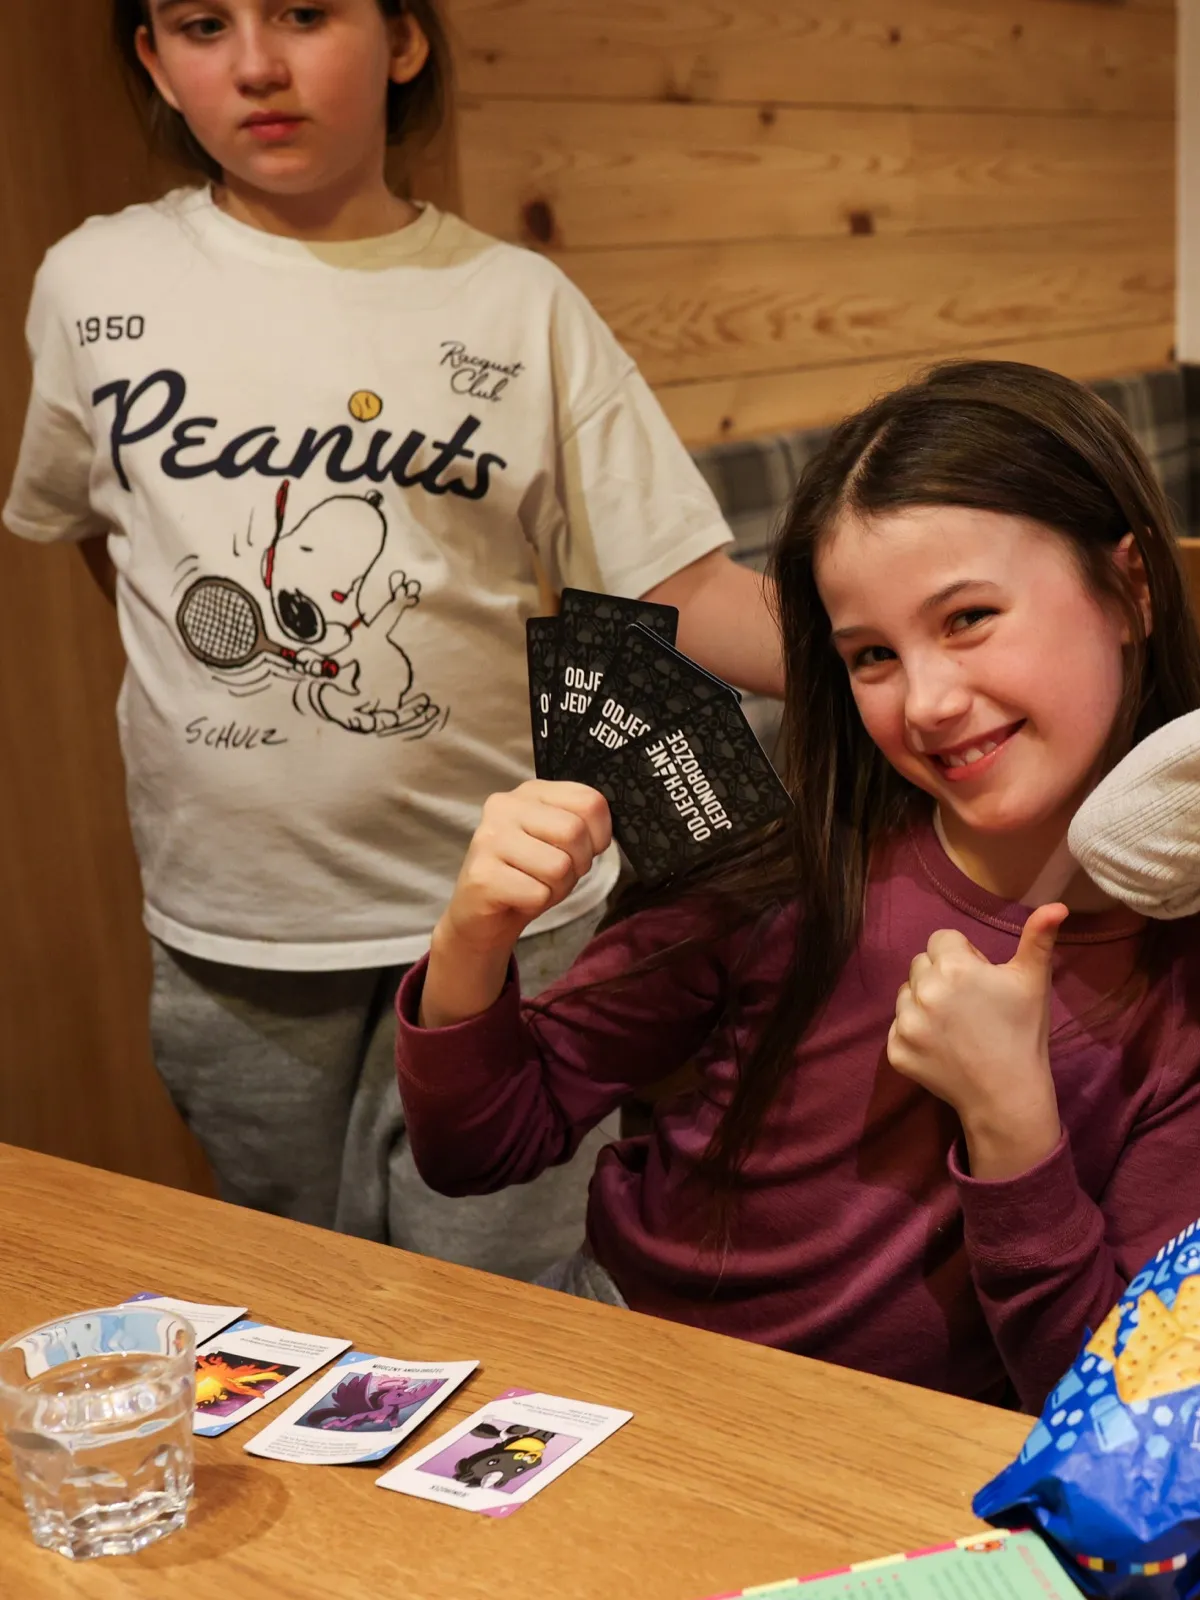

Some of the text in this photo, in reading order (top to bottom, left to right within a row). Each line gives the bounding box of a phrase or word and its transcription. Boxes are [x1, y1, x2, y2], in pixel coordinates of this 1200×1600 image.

[76, 315, 145, 346] 1950
[440, 340, 525, 378] Racquet
[450, 367, 502, 402] Club
[92, 368, 508, 500] Peanuts
[185, 716, 288, 749] SCHULZ
[645, 739, 711, 842] ODJECHANE
[665, 728, 733, 830] JEDNOROŻCE
